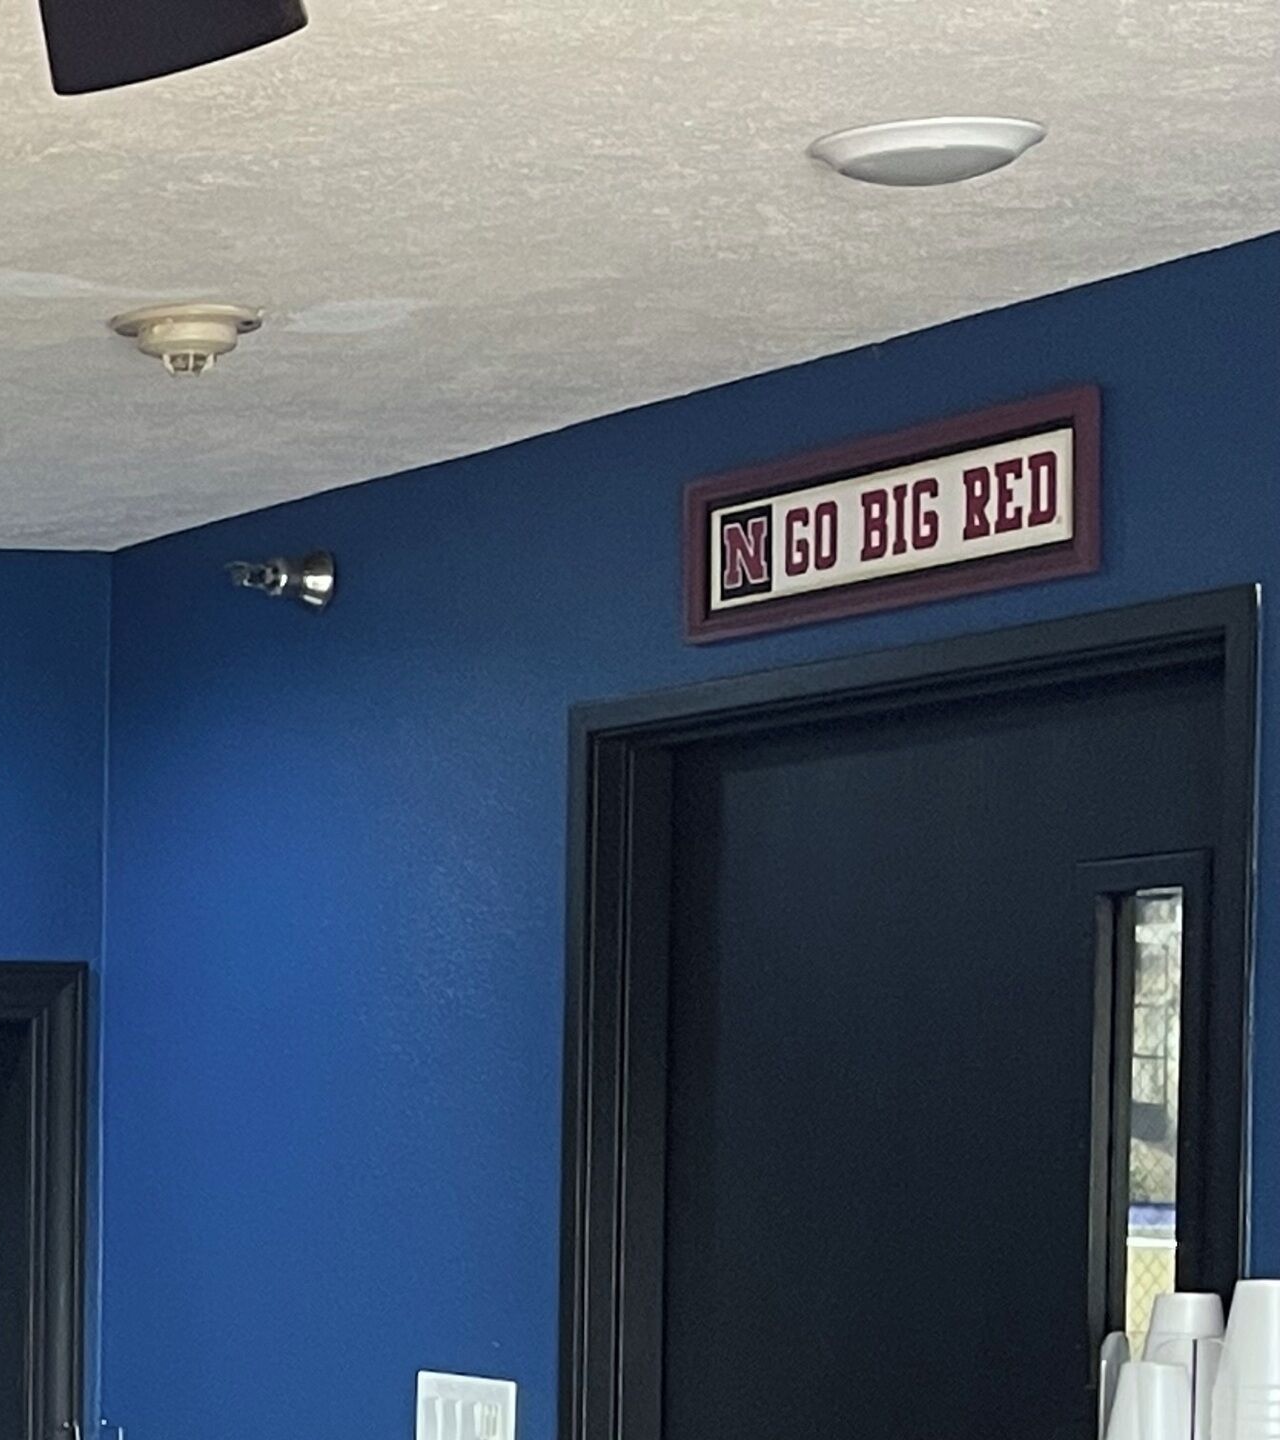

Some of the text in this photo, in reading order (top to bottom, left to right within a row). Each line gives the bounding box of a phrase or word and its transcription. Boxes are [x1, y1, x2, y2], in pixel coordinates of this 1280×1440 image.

[724, 451, 1058, 589] N GO BIG RED
